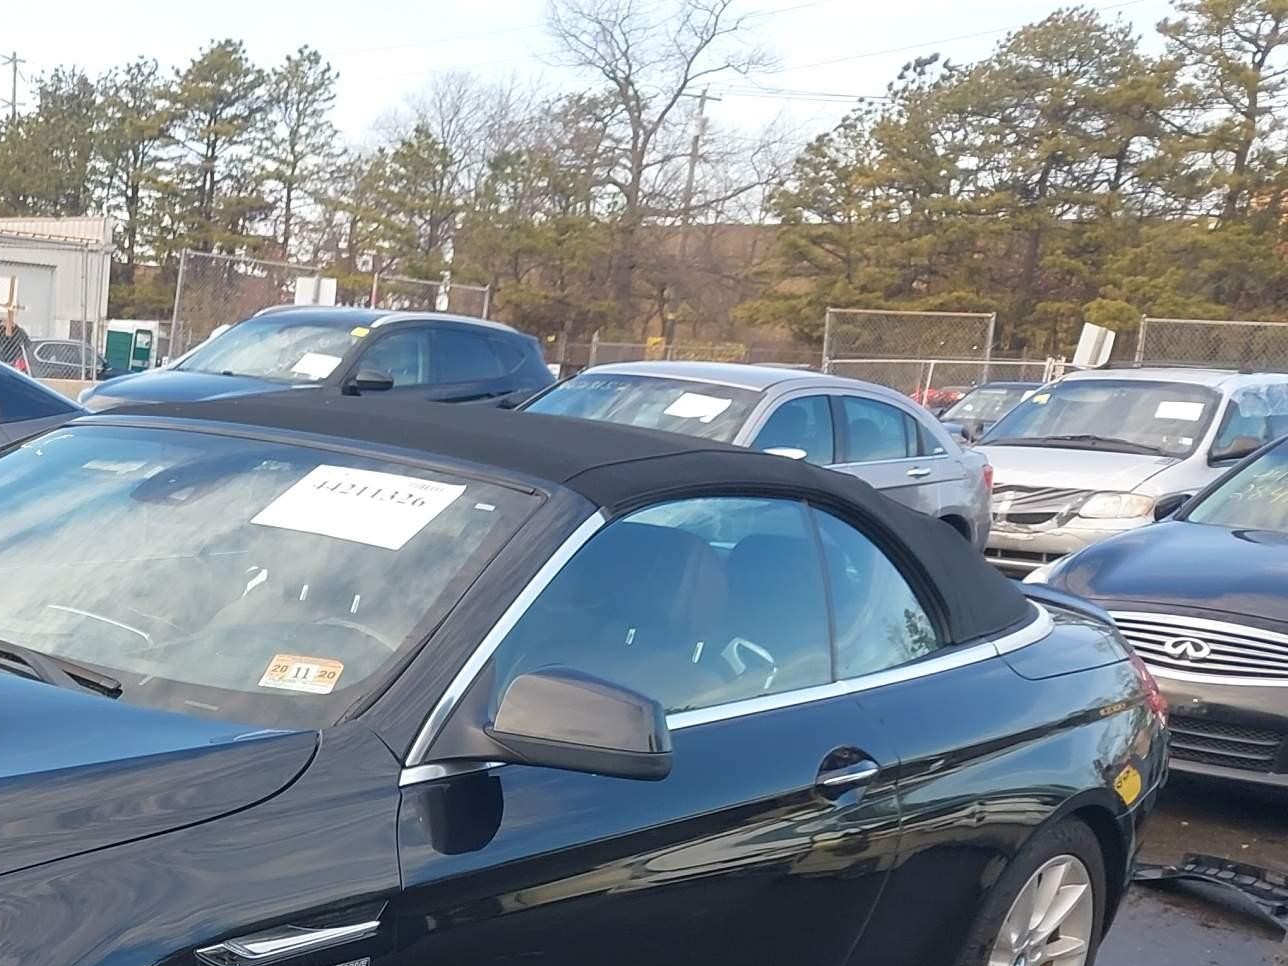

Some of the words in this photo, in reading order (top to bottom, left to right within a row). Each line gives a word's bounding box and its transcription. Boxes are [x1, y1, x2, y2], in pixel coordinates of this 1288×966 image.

[272, 664, 289, 673] 20
[293, 667, 311, 680] 11
[317, 670, 336, 680] 20
